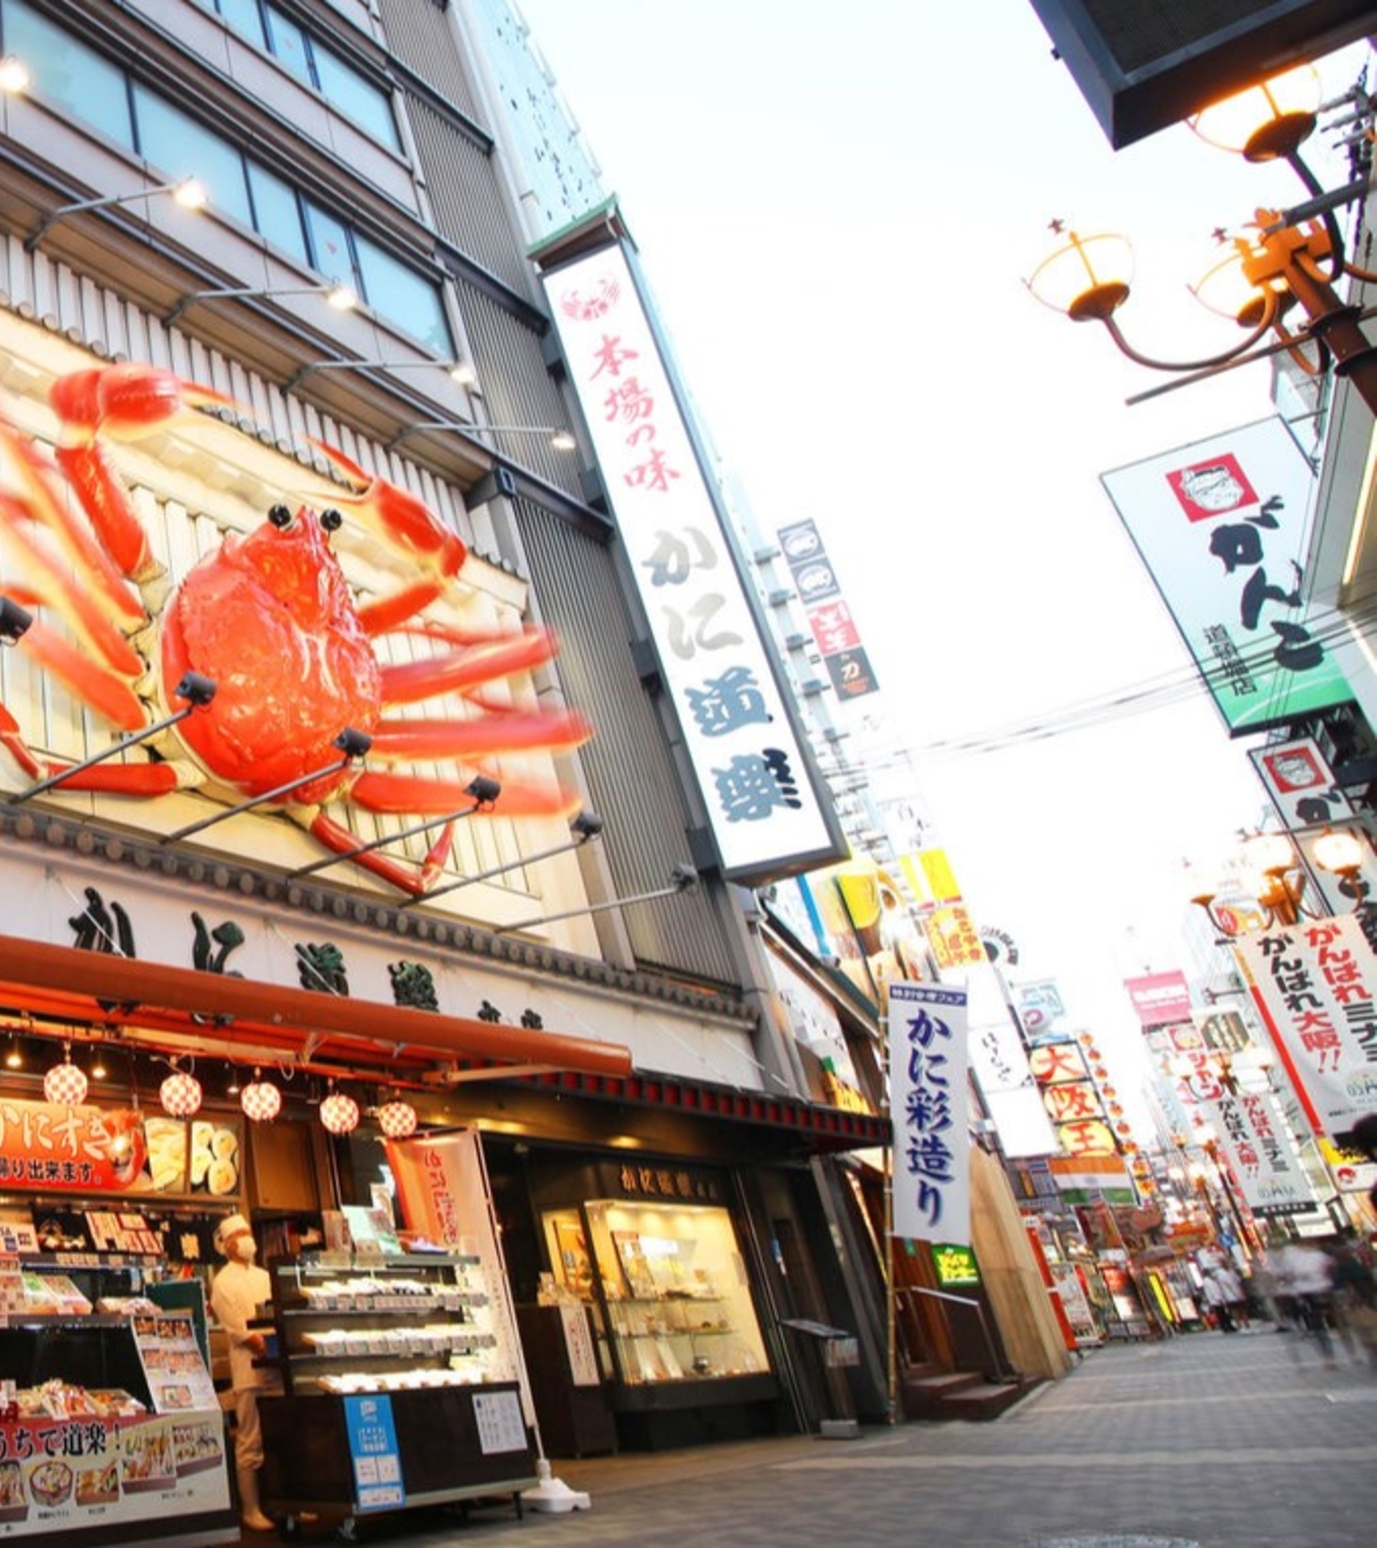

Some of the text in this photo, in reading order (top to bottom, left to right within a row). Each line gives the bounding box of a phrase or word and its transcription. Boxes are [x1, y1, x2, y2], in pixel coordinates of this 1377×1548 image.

[588, 333, 683, 493] 本場の味
[641, 525, 803, 824] かに道楽
[1209, 495, 1325, 671] がんこ
[905, 1008, 955, 1228] かに彩造り
